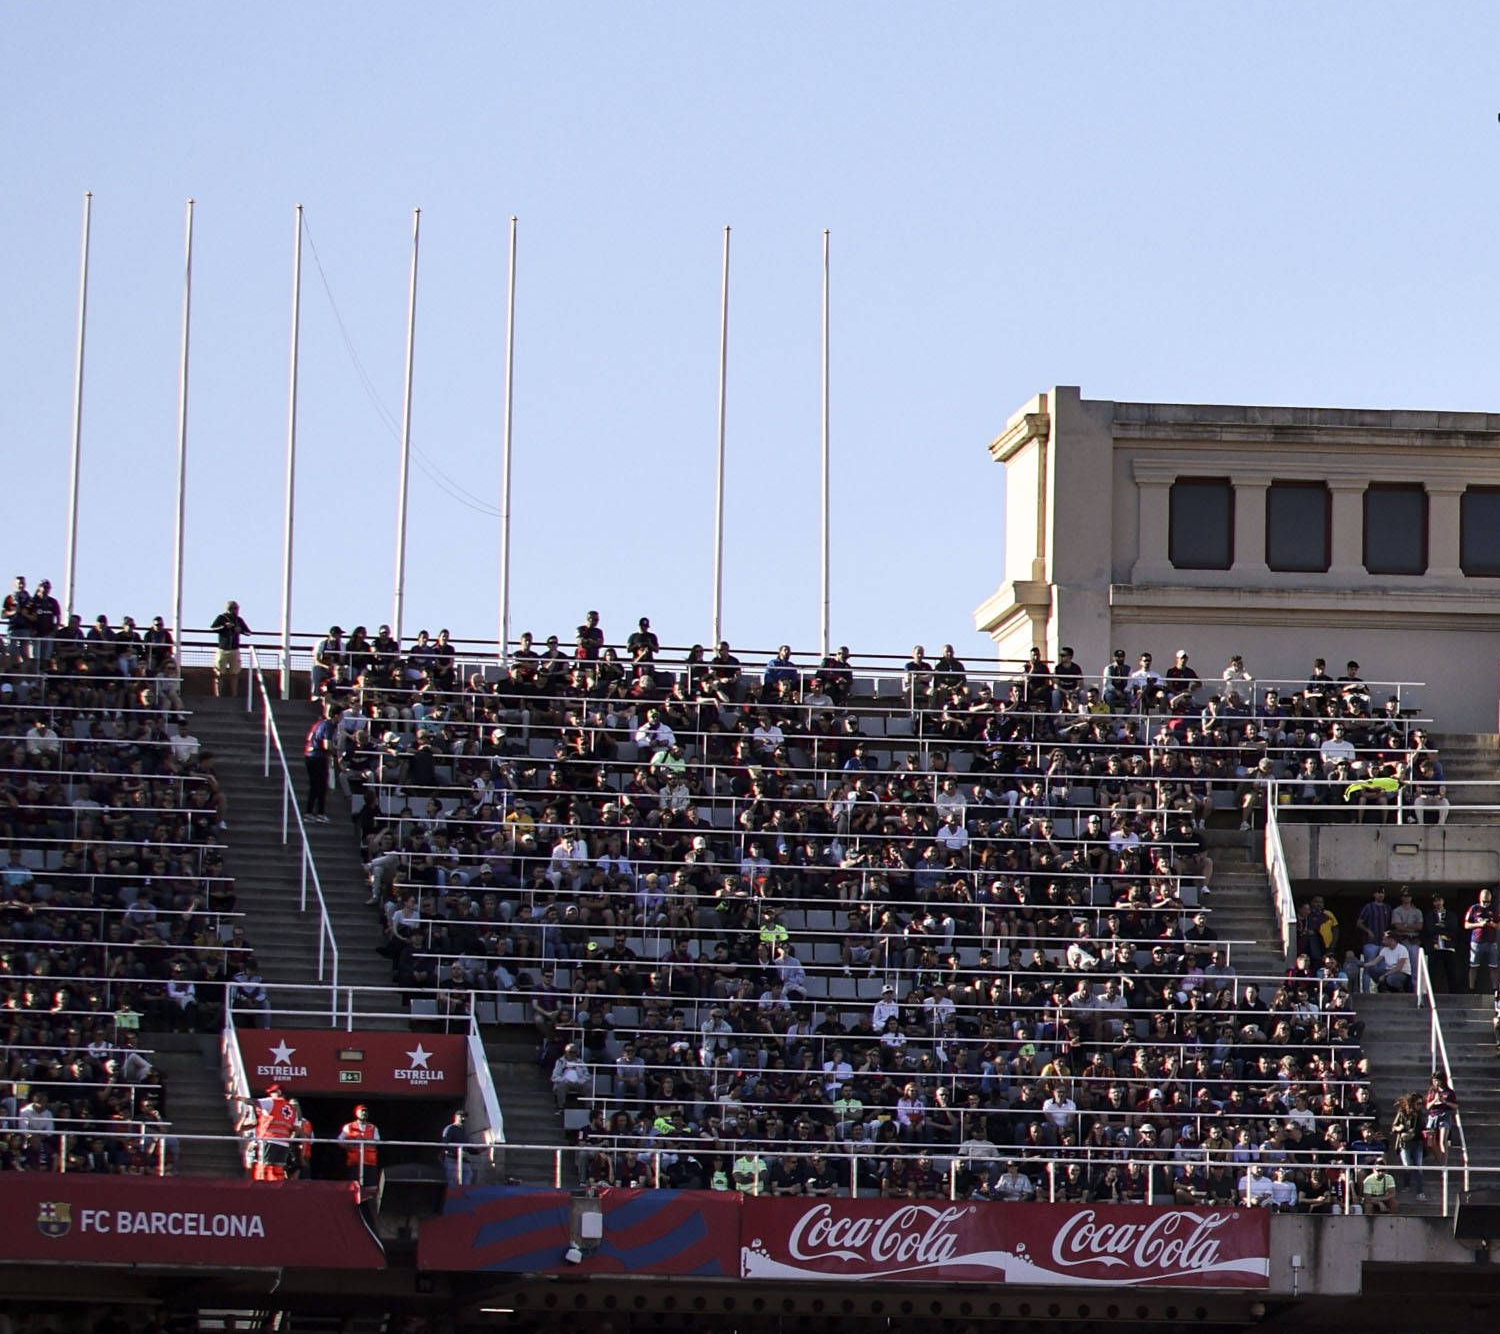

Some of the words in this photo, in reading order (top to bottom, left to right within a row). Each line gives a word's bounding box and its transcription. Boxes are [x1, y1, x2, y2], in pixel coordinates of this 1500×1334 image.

[257, 1065, 307, 1076] ESTRELLA
[394, 1069, 444, 1080] ESTRELLA
[80, 1209, 111, 1233] FC
[117, 1211, 265, 1237] BARCELONA
[788, 1203, 970, 1263] Coca-Cola
[1051, 1209, 1233, 1268] Coca-Cola
